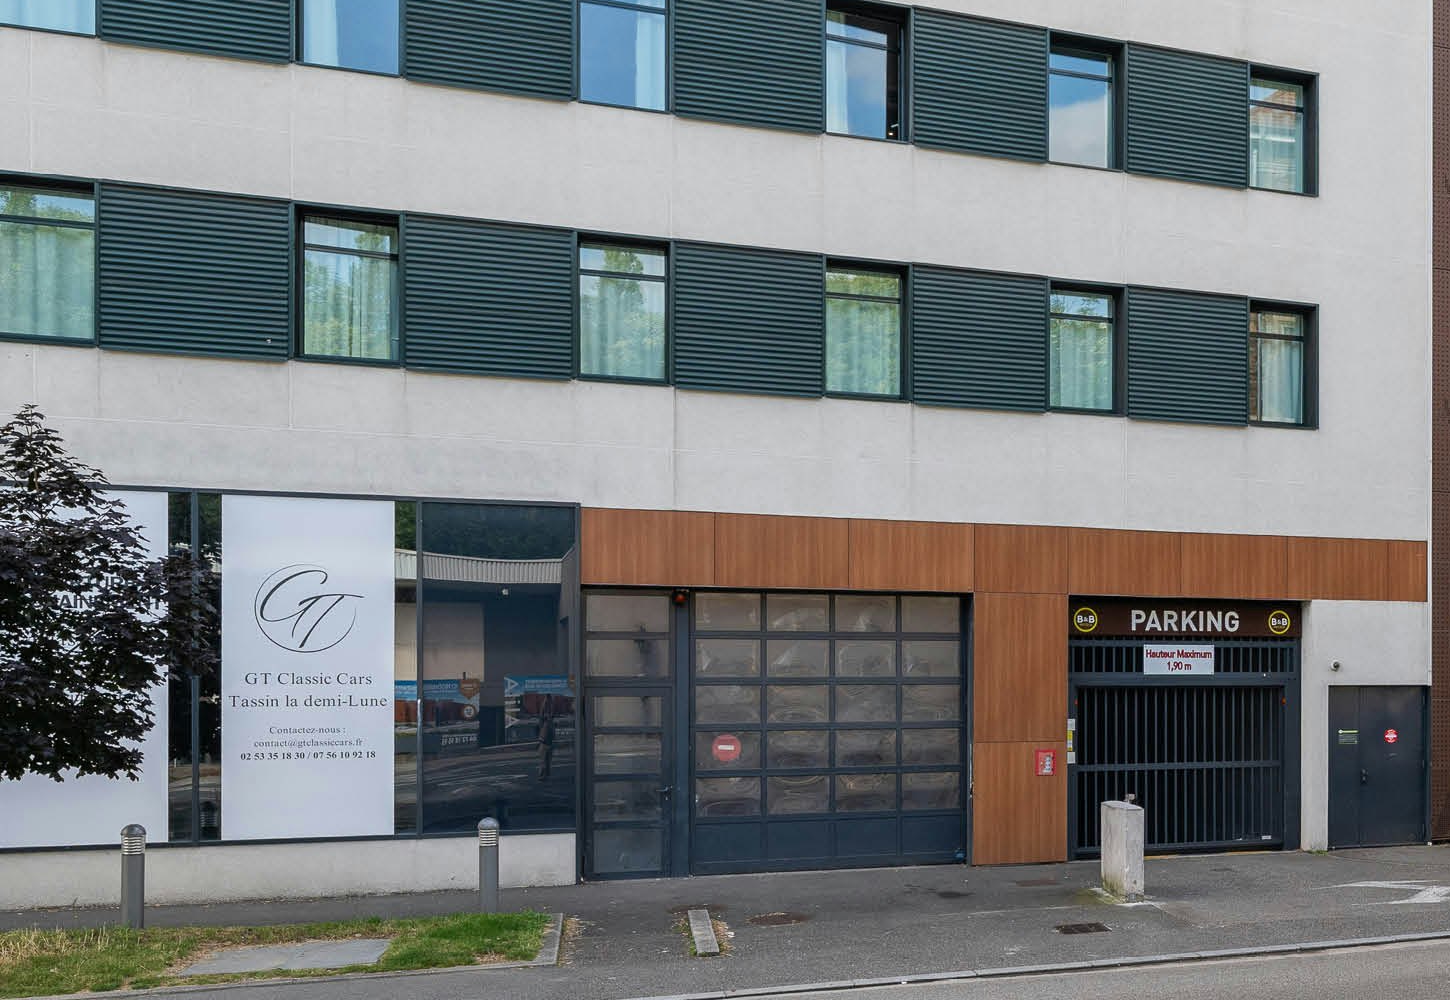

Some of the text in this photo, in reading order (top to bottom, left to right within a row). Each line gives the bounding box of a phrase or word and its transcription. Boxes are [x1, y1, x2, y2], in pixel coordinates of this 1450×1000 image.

[1076, 615, 1095, 623] B&B
[1130, 609, 1240, 633] PARKING
[1271, 617, 1288, 626] B&B
[1146, 650, 1212, 659] Hauteur Maximum
[1166, 661, 1183, 671] 1,90
[277, 672, 332, 685] Classic
[336, 672, 373, 685] Cars
[228, 695, 388, 707] Tassin la demi-Lune
[269, 726, 342, 734] Contactez-nous
[253, 738, 363, 748] contact@gtclassiccars.fr
[294, 752, 305, 760] 30
[366, 751, 376, 759] 18
